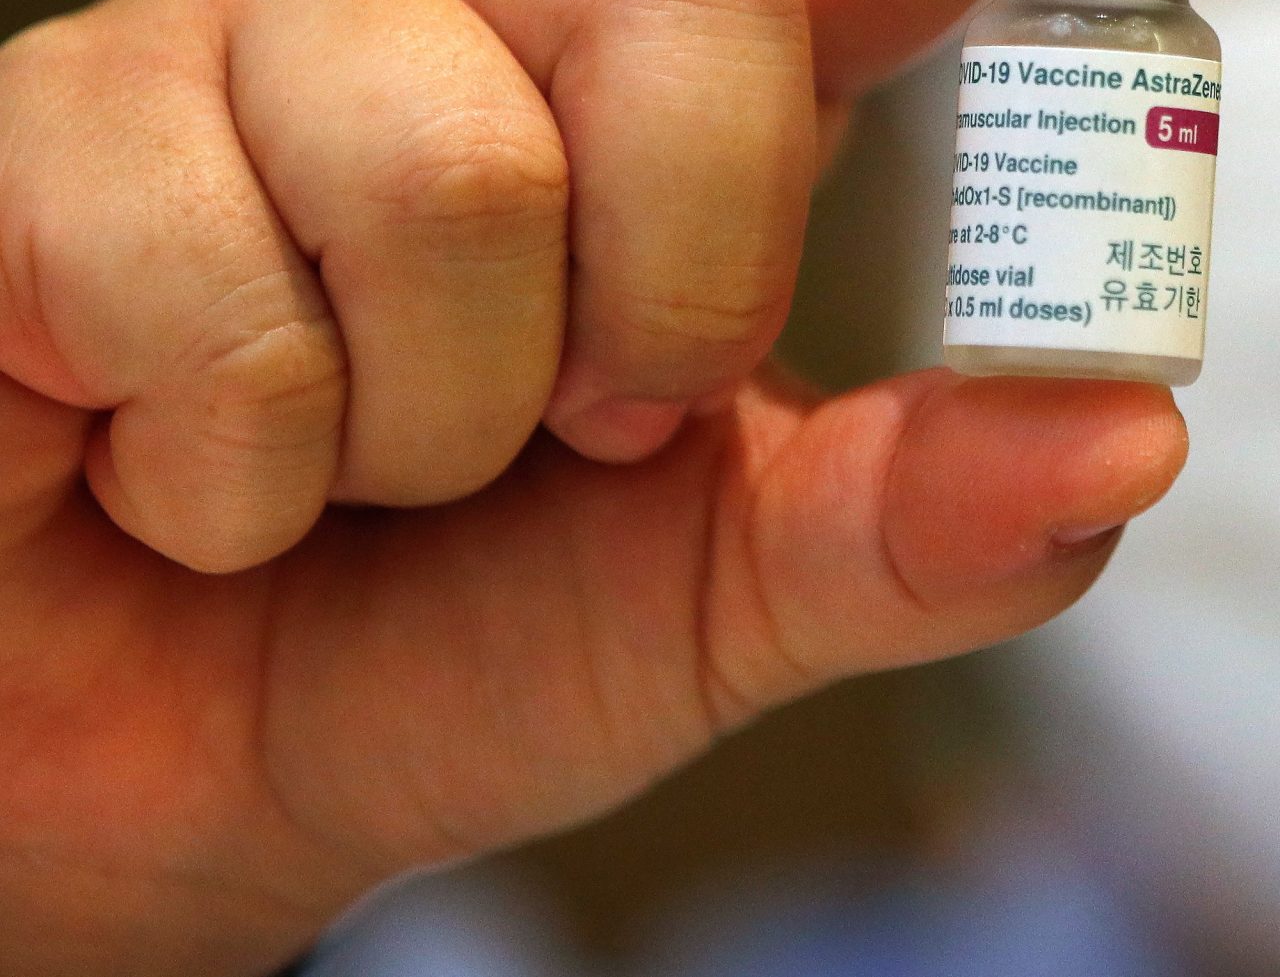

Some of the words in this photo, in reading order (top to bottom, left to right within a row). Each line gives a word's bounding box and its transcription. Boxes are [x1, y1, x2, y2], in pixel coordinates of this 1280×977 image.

[1018, 61, 1122, 90] Vaccine
[1131, 68, 1221, 101] AstraZene
[1037, 110, 1136, 135] Injection
[1157, 115, 1173, 142] 5
[1178, 124, 1197, 144] ml
[953, 152, 989, 173] VID-19
[995, 152, 1078, 175] Vaccine
[952, 186, 1011, 206] AdOx1-S
[1017, 187, 1176, 219] [recombinant])
[960, 225, 971, 243] at
[1106, 239, 1202, 277] 제조번호
[996, 265, 1034, 287] vial
[955, 296, 975, 317] 0.5
[979, 297, 1003, 318] ml
[1009, 297, 1092, 327] doses)
[1100, 279, 1200, 318] 유효기한
